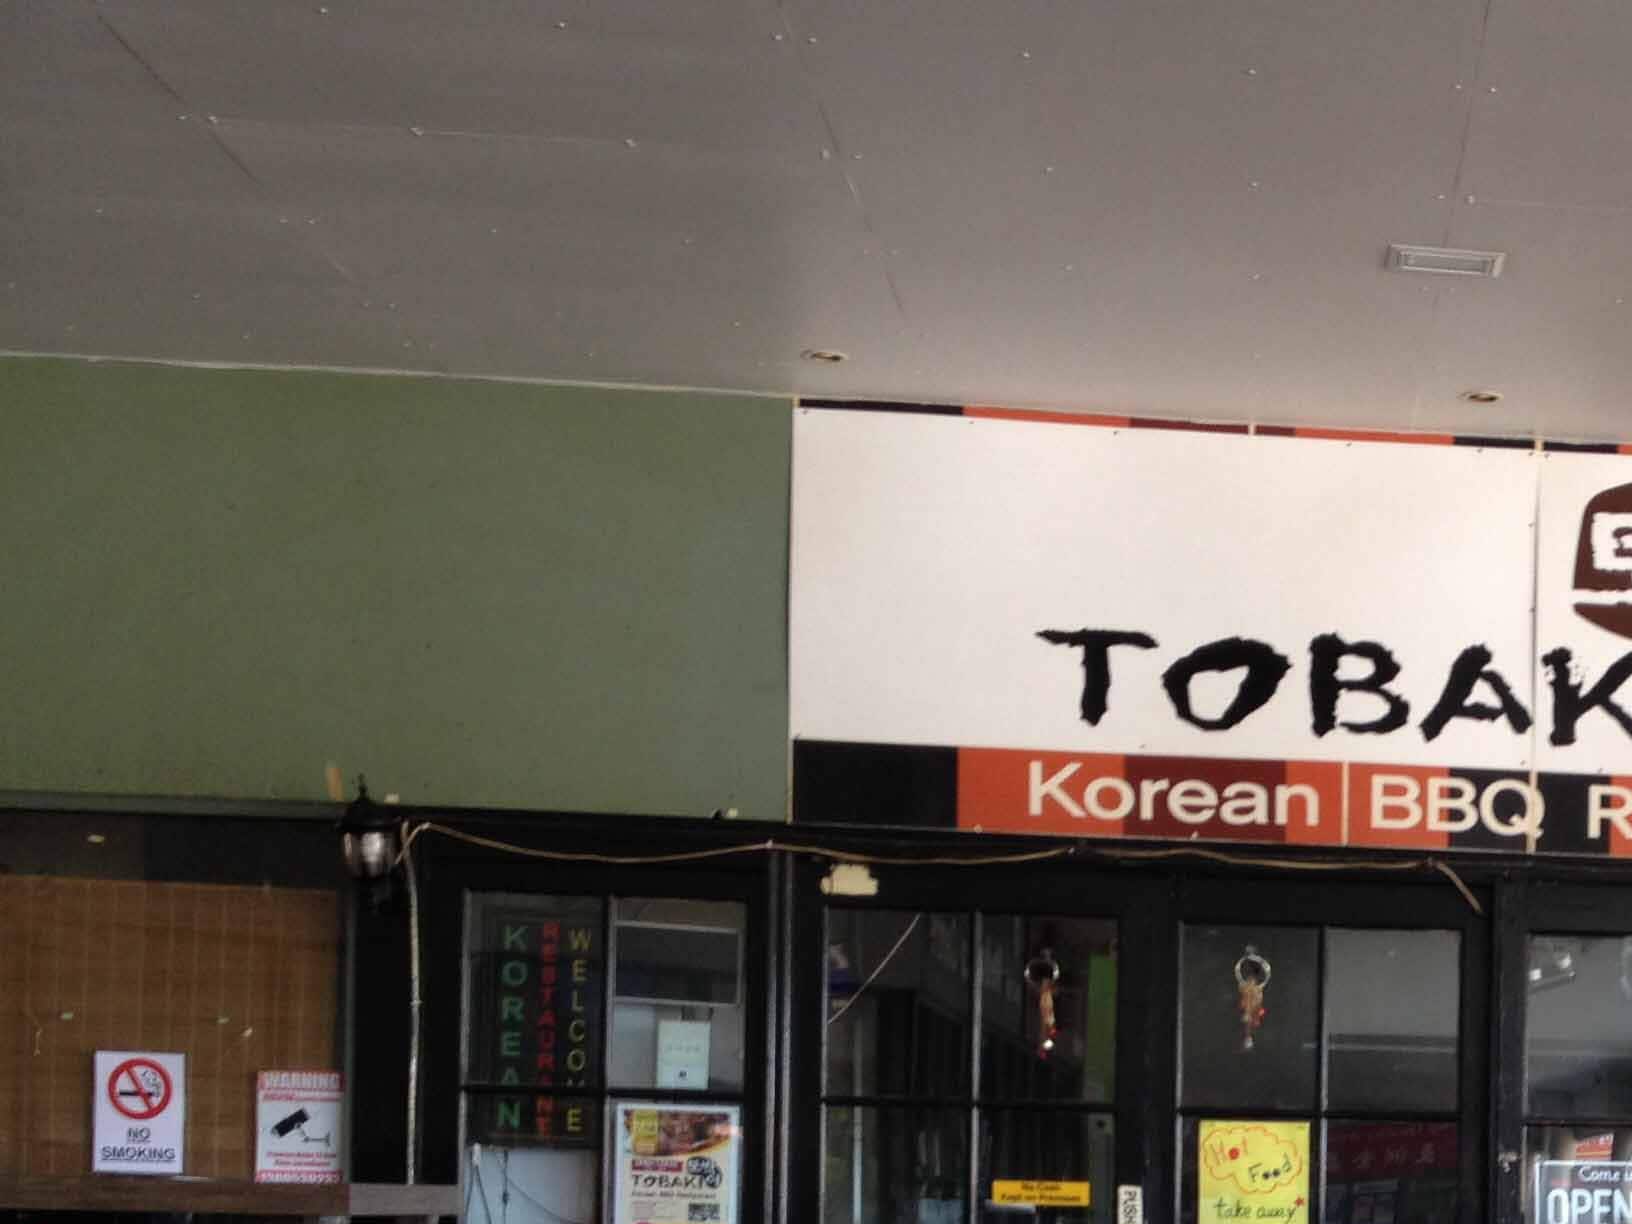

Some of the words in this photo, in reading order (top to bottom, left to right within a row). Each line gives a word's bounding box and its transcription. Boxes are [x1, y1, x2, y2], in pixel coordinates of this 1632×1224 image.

[1028, 760, 1321, 826] Korean
[1370, 773, 1546, 840] BBQ
[498, 924, 529, 1129] KOREAN
[127, 1127, 151, 1139] NO
[102, 1146, 176, 1160] SMOKING
[632, 1173, 703, 1189] TOBAKI
[1577, 1166, 1620, 1182] Come
[1123, 1190, 1138, 1224] PUSH
[1214, 1197, 1250, 1219] take
